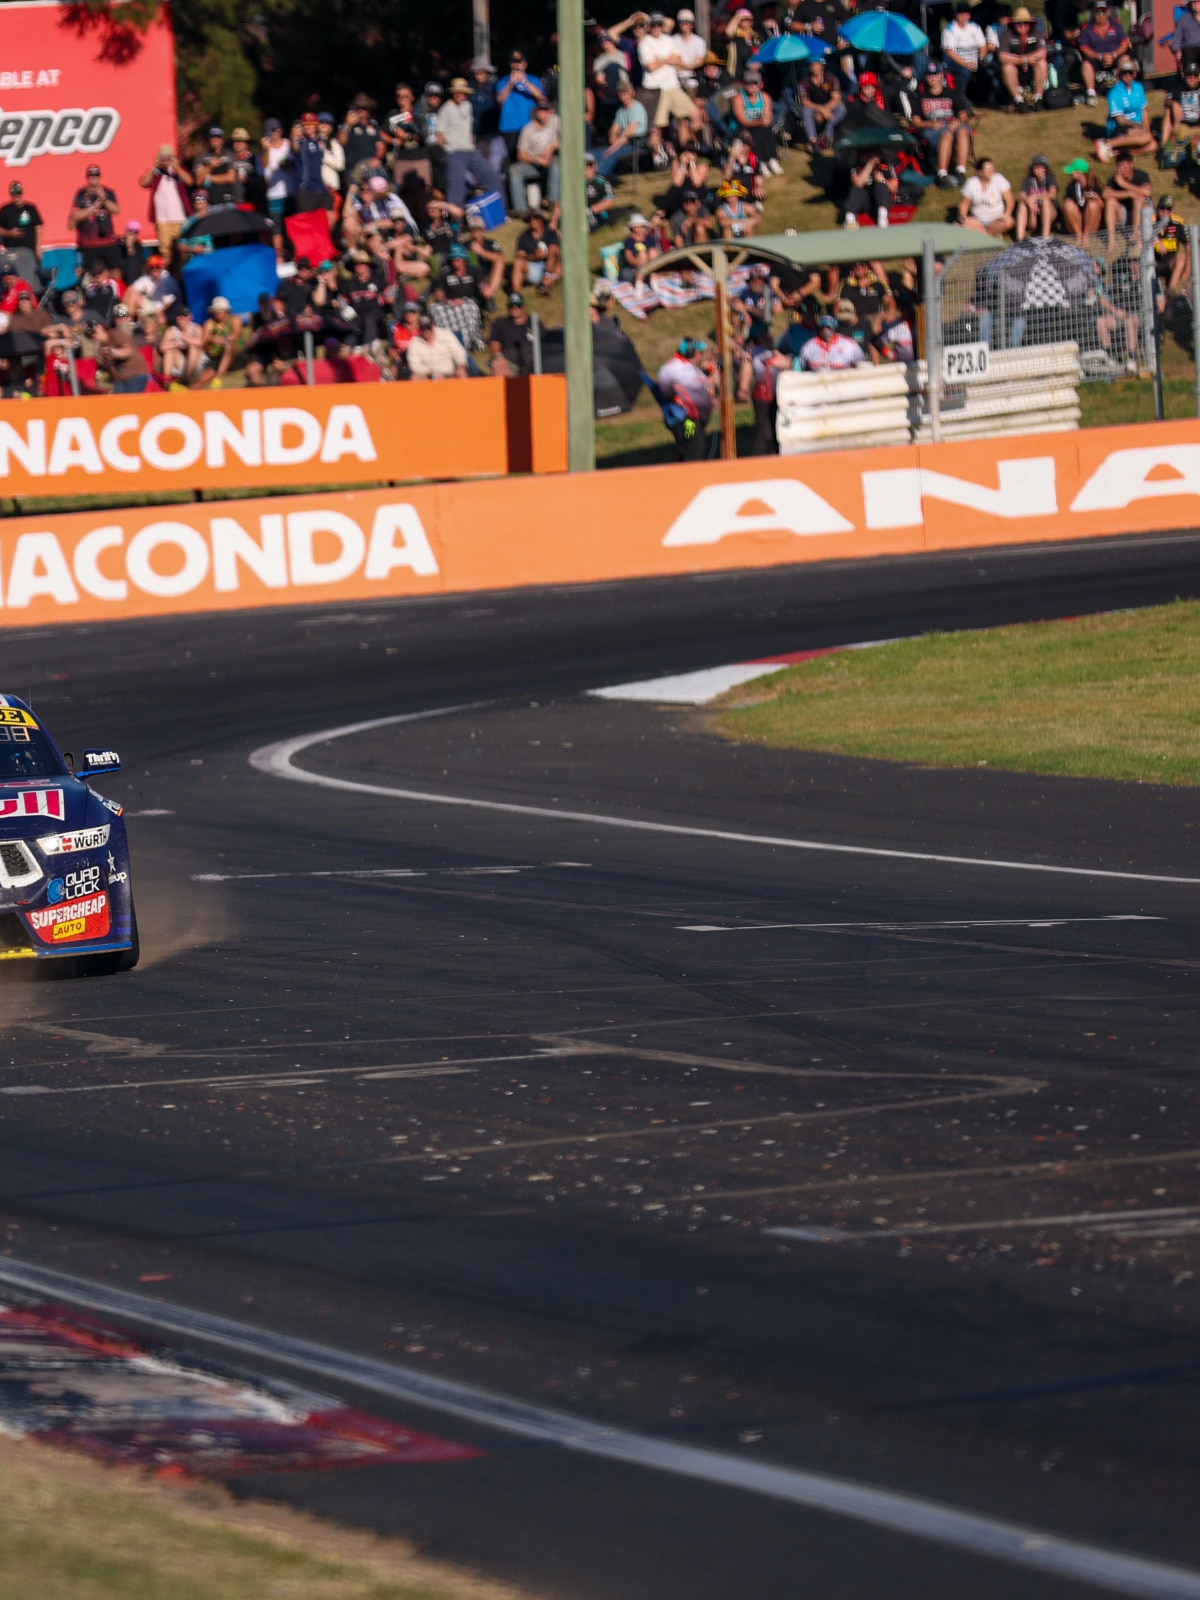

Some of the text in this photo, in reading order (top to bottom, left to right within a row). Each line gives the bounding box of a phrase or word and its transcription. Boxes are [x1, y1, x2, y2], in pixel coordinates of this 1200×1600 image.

[37, 69, 61, 88] AT
[947, 350, 987, 377] P23.0
[663, 445, 1200, 545] ANA
[65, 866, 100, 886] QUAD
[65, 878, 100, 900] LOCK
[31, 895, 107, 930] SUPERCHEAP
[54, 922, 82, 936] AUTO
